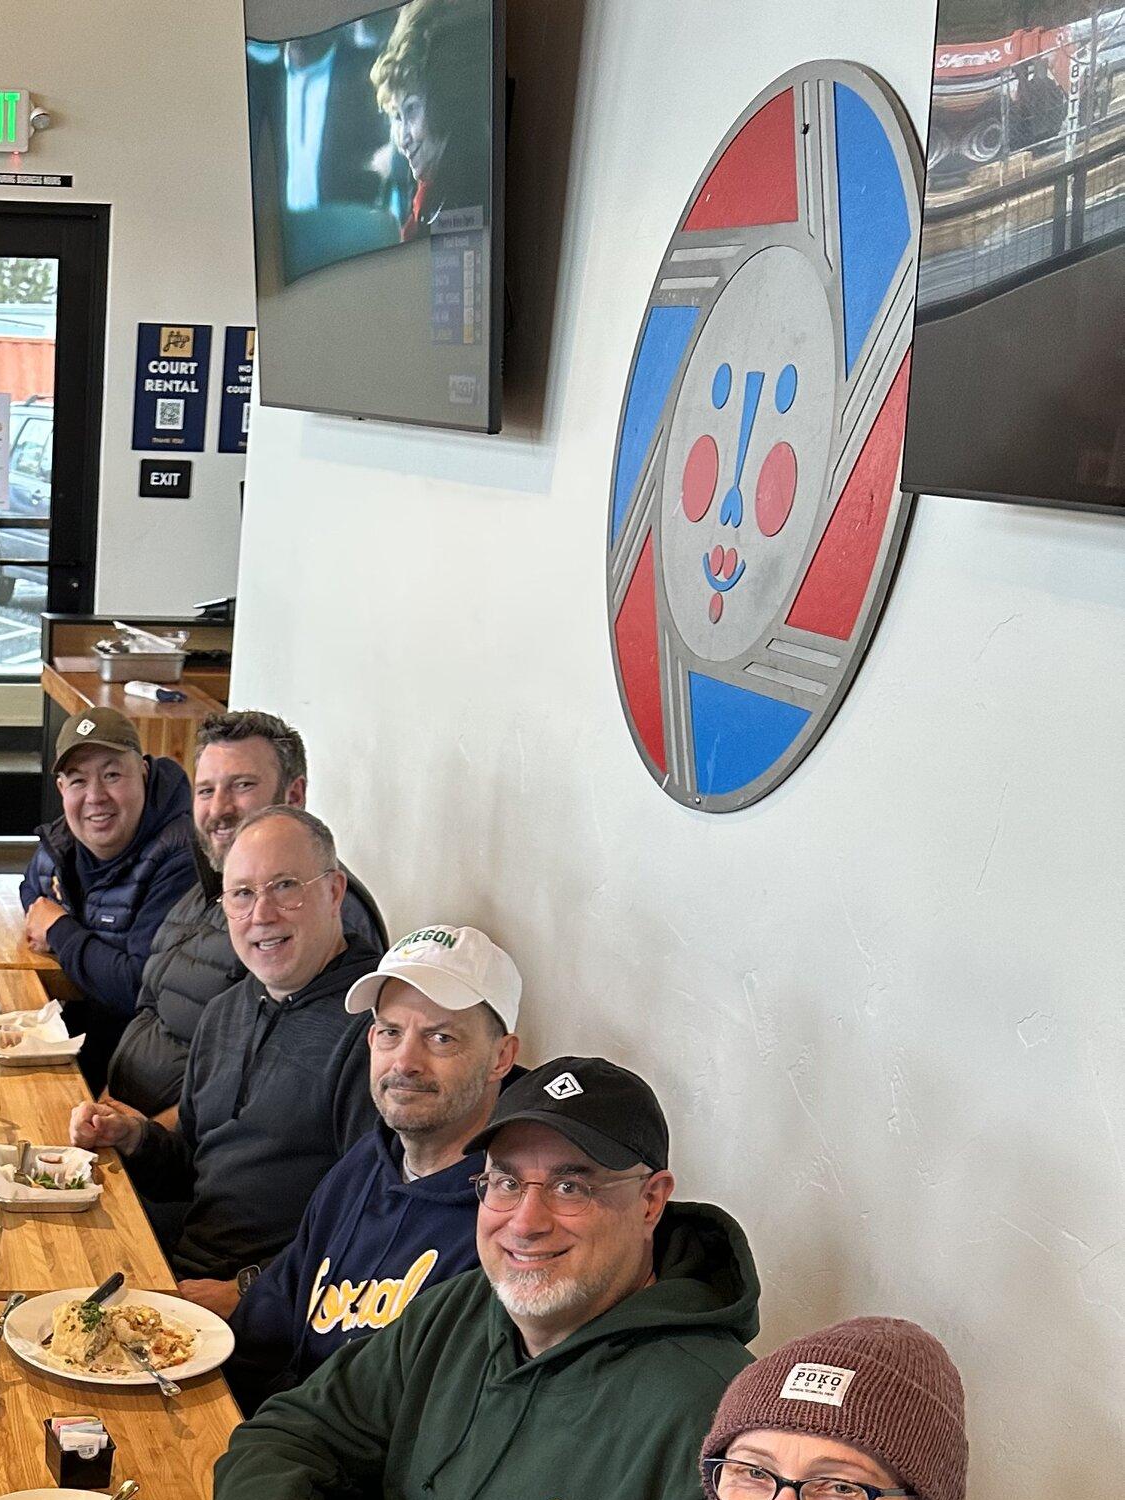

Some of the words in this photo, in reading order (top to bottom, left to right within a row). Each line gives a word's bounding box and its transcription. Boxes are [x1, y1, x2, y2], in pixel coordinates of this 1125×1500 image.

[148, 361, 198, 375] COURT
[145, 379, 199, 393] RENTAL
[150, 472, 181, 486] EXIT
[794, 1371, 842, 1387] POKO
